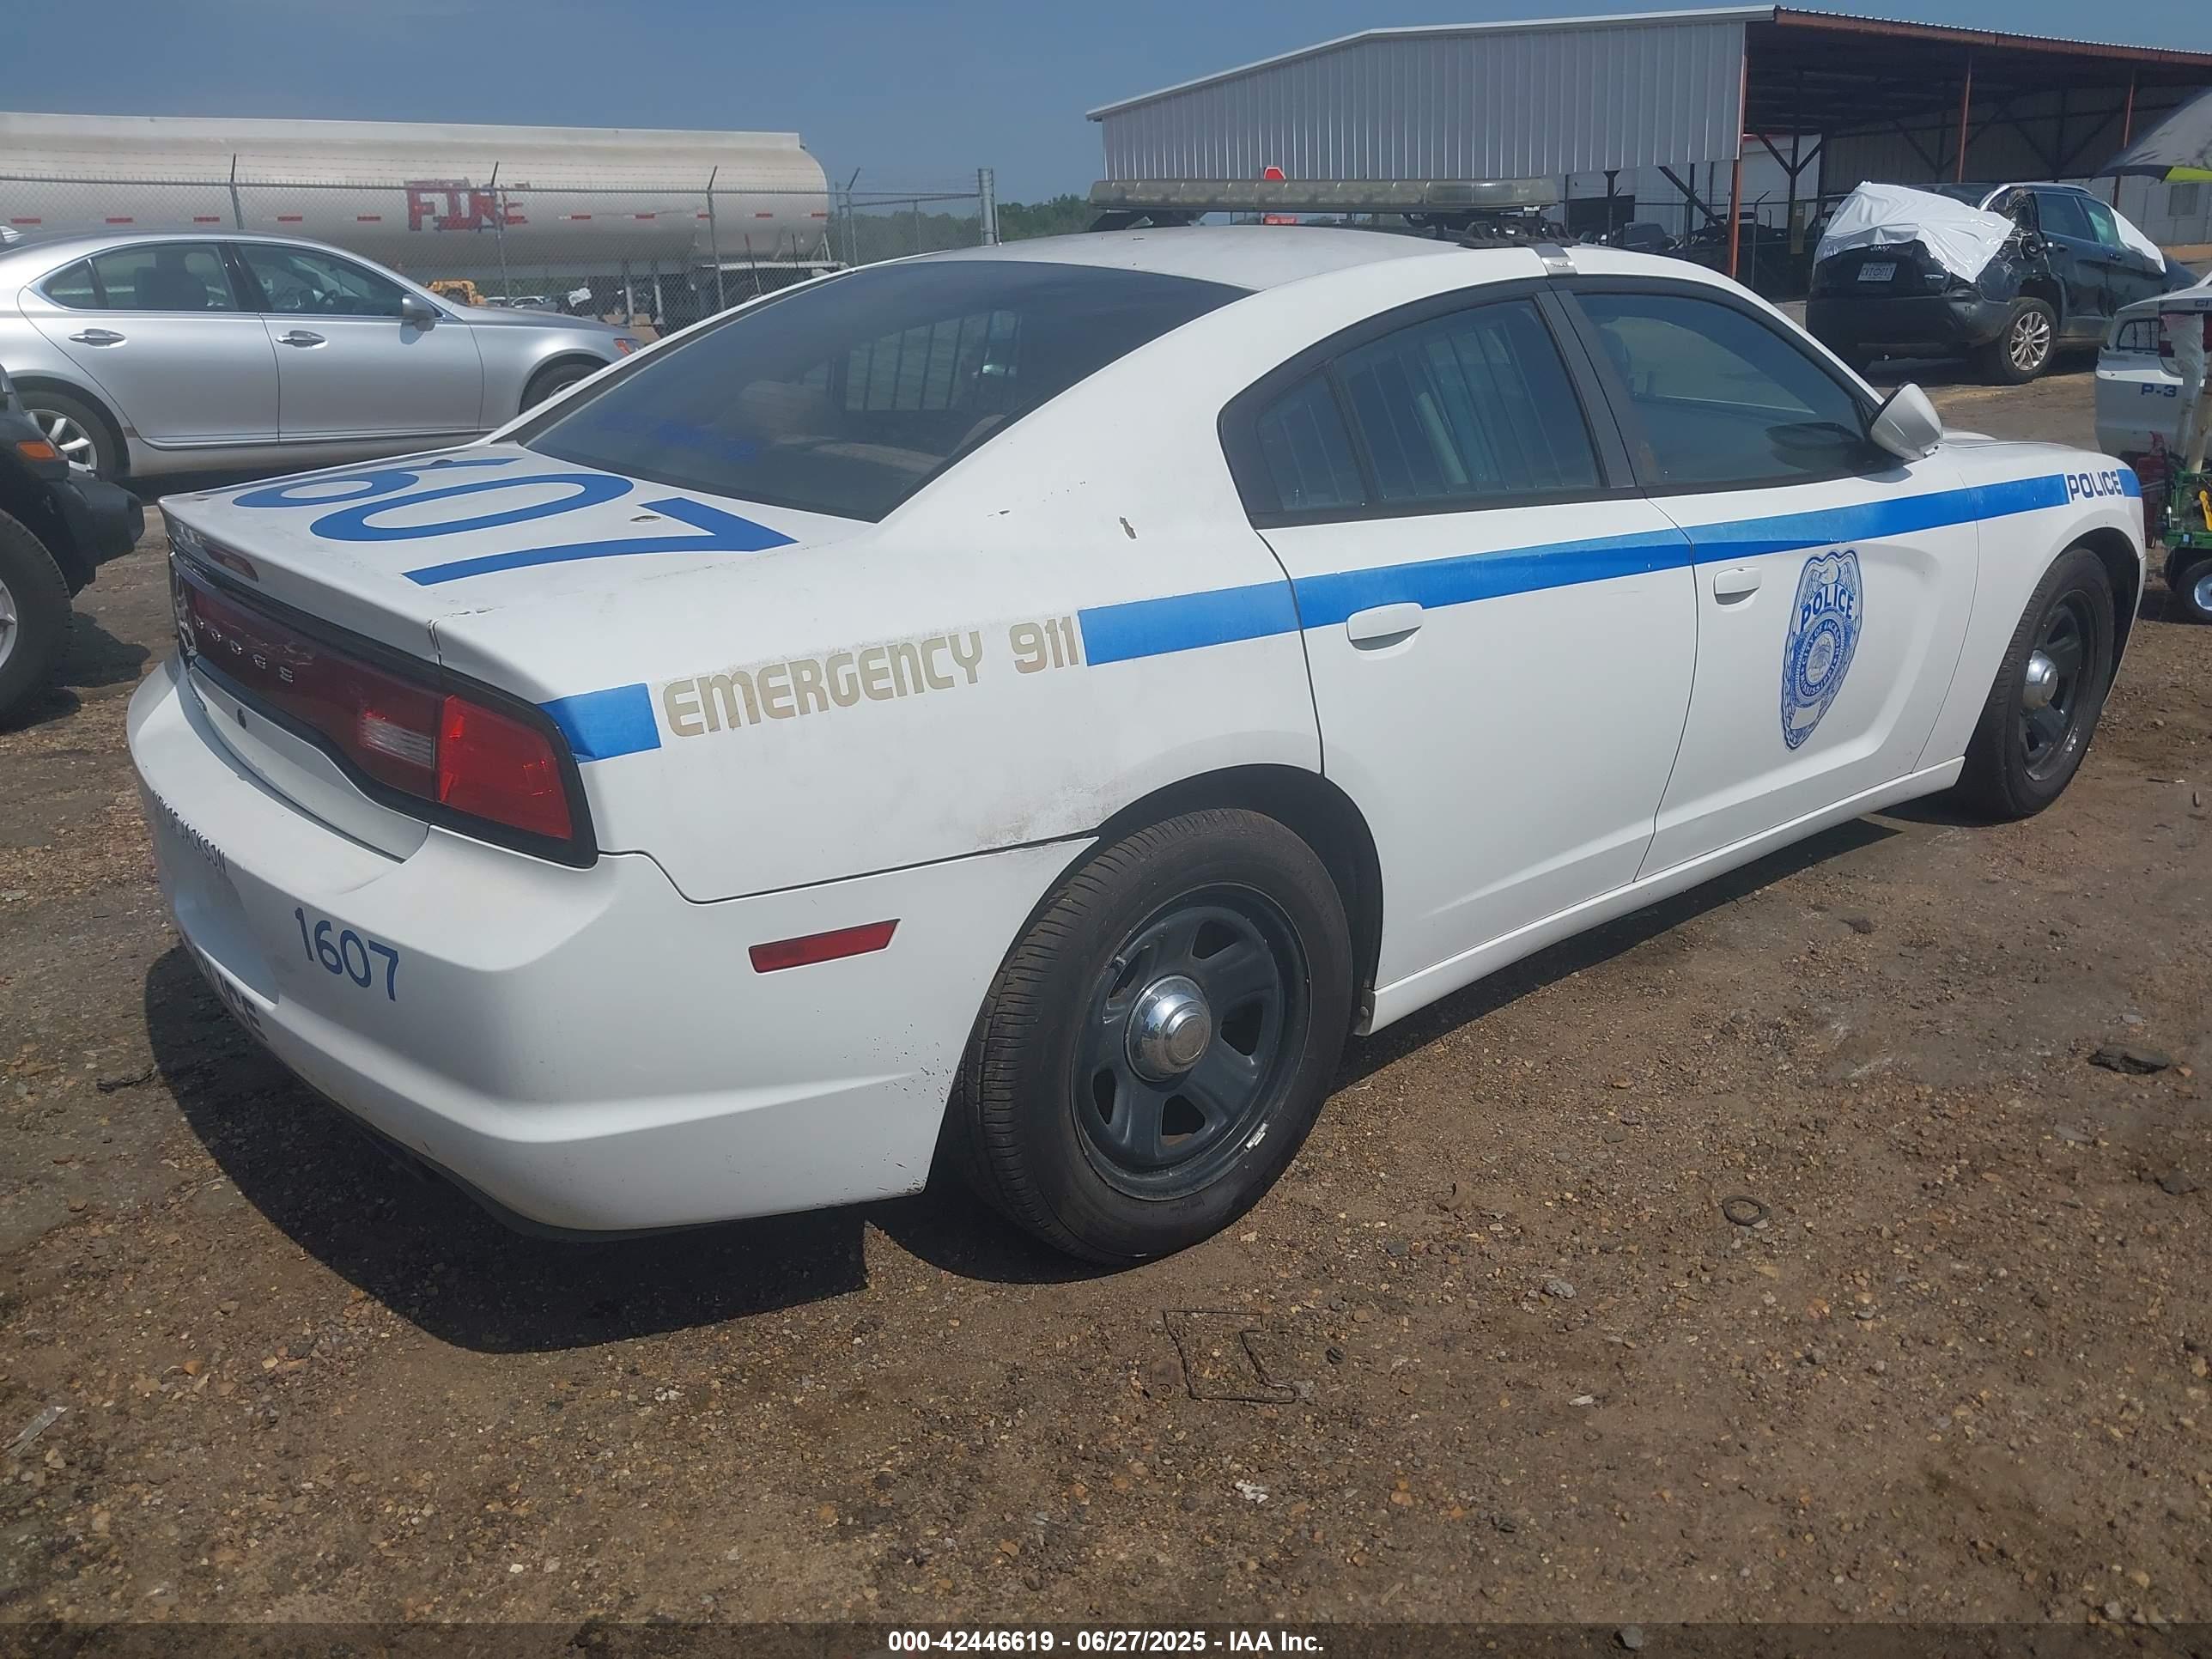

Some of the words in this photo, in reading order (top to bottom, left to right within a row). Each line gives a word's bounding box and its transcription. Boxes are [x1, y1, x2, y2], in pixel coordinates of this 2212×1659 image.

[2141, 383, 2177, 398] P-3
[2066, 471, 2123, 501] POLICE
[1800, 584, 1854, 633] POLICE
[1802, 635, 1814, 665] CITY
[1814, 624, 1824, 636] OF
[662, 629, 983, 738] EMERGENCY
[1008, 615, 1079, 675] 911
[295, 907, 399, 1002] 1607
